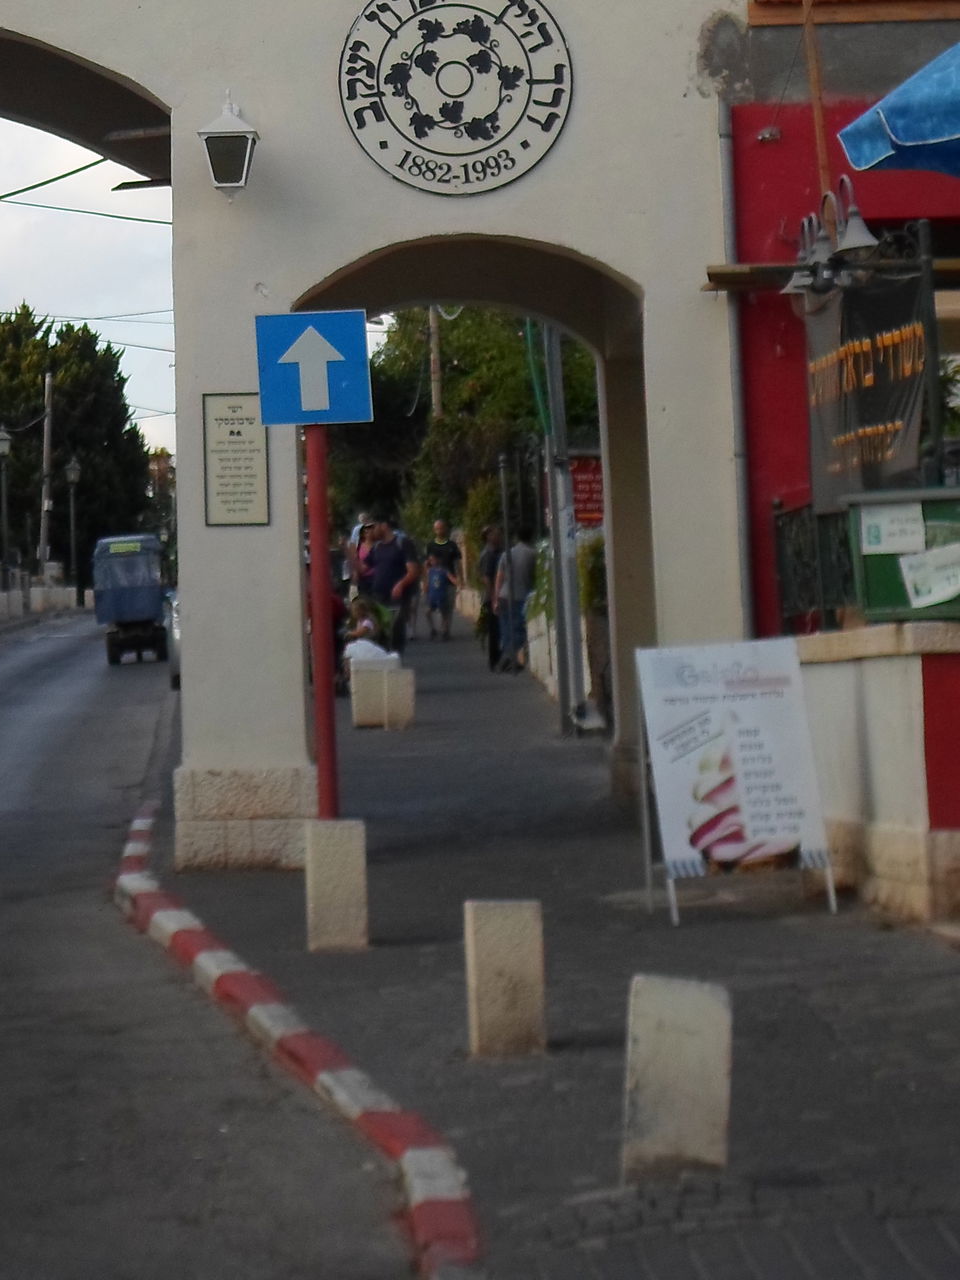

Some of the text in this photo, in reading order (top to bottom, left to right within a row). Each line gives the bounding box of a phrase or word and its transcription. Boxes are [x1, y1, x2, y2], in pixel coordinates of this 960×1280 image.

[345, 40, 386, 130] יעקב
[526, 63, 567, 132] דרך
[395, 148, 516, 185] 1882-1993
